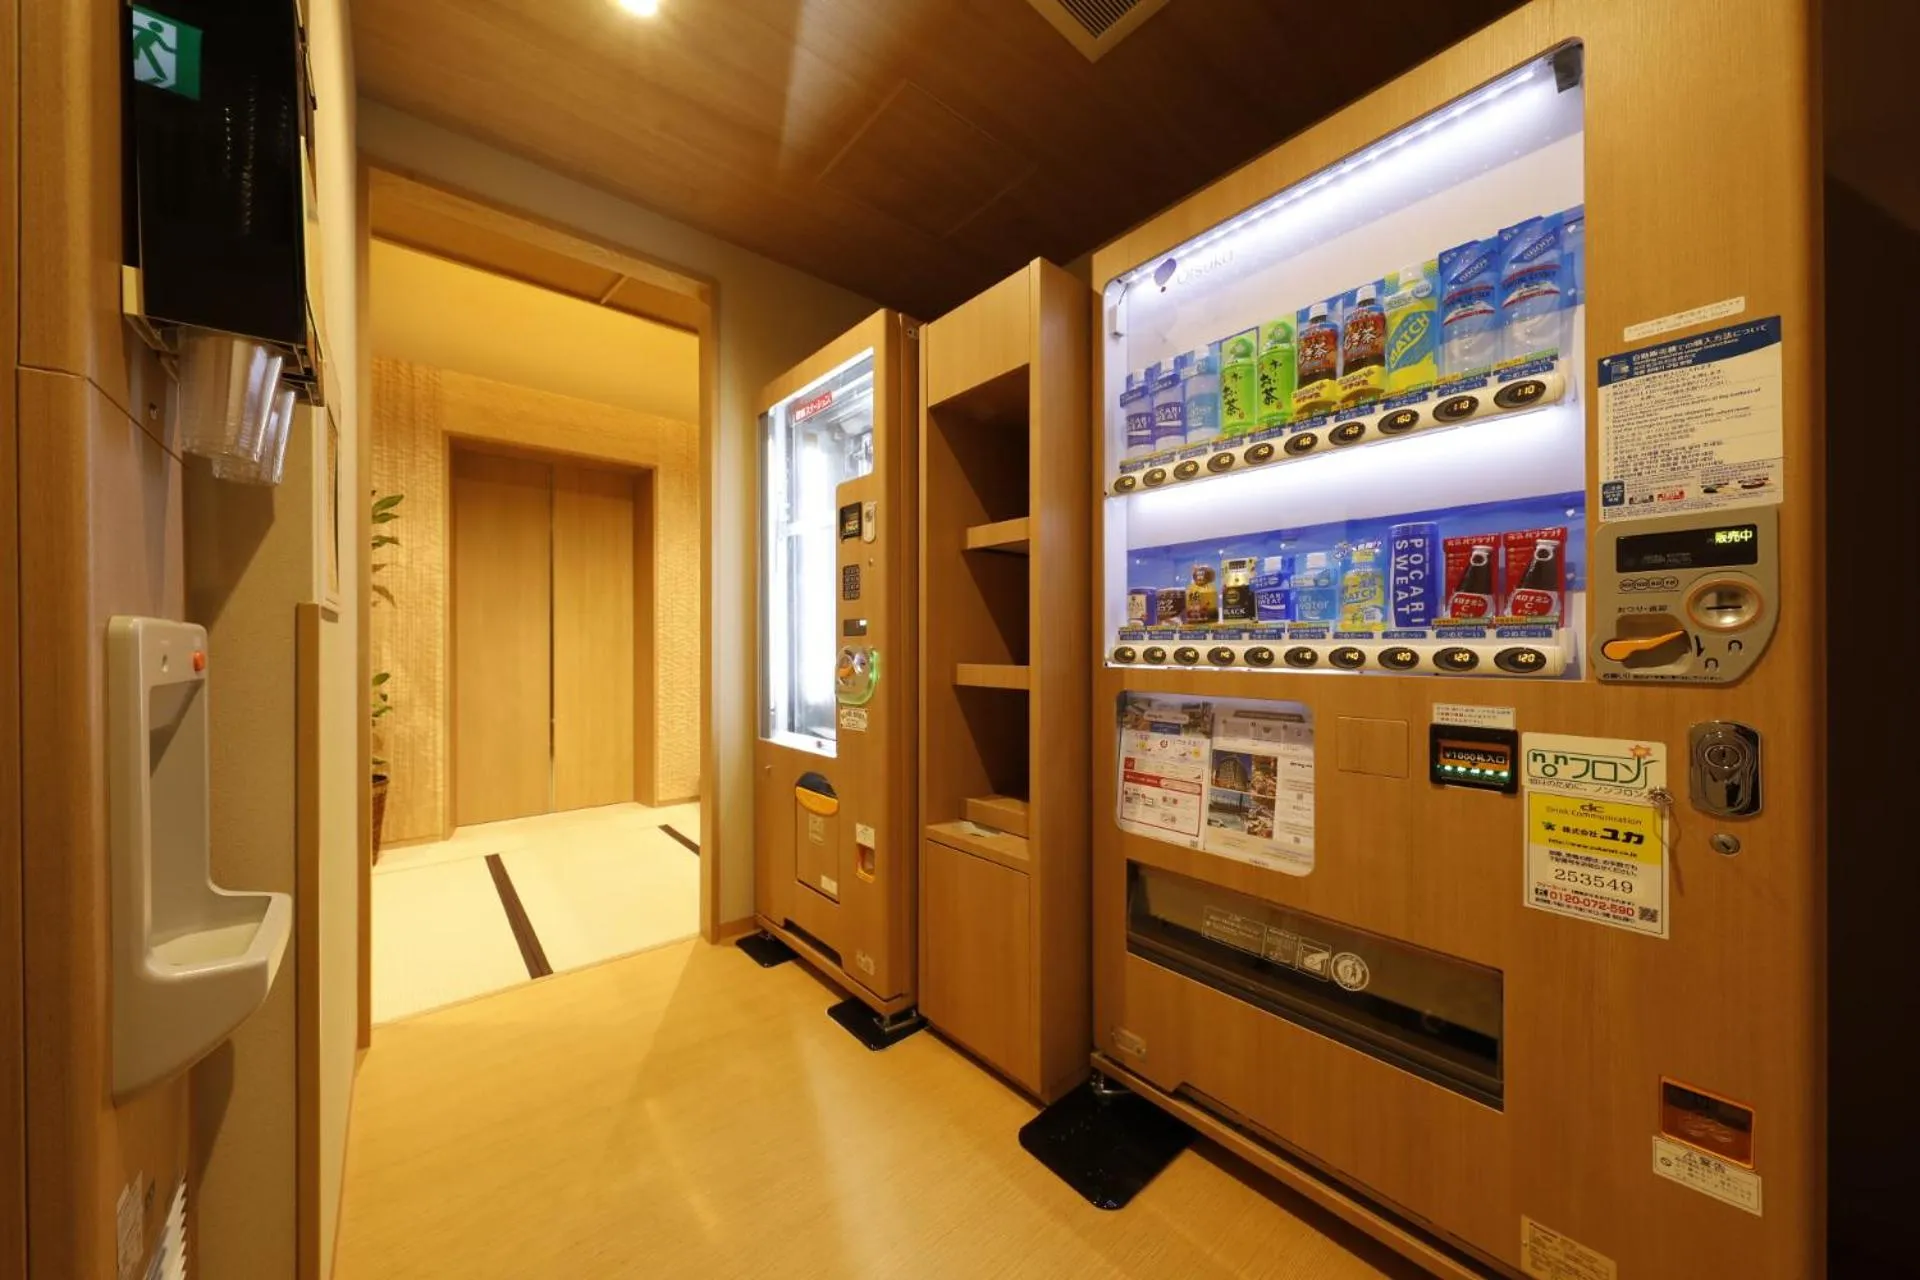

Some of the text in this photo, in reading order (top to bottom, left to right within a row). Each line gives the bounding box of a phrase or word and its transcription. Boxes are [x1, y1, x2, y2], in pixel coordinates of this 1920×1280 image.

[1389, 313, 1429, 368] MATCH
[1715, 529, 1753, 544] 販売中
[1394, 539, 1410, 615] SWEAT
[1409, 537, 1425, 623] POCARI
[1223, 606, 1246, 616] BLACK
[1396, 652, 1412, 662] 120
[1453, 652, 1470, 663] 120
[1517, 653, 1536, 664] 120
[1562, 826, 1644, 846] 株式会社 ユカ
[1554, 867, 1634, 895] 253549
[1549, 889, 1635, 918] 0120-072-590
